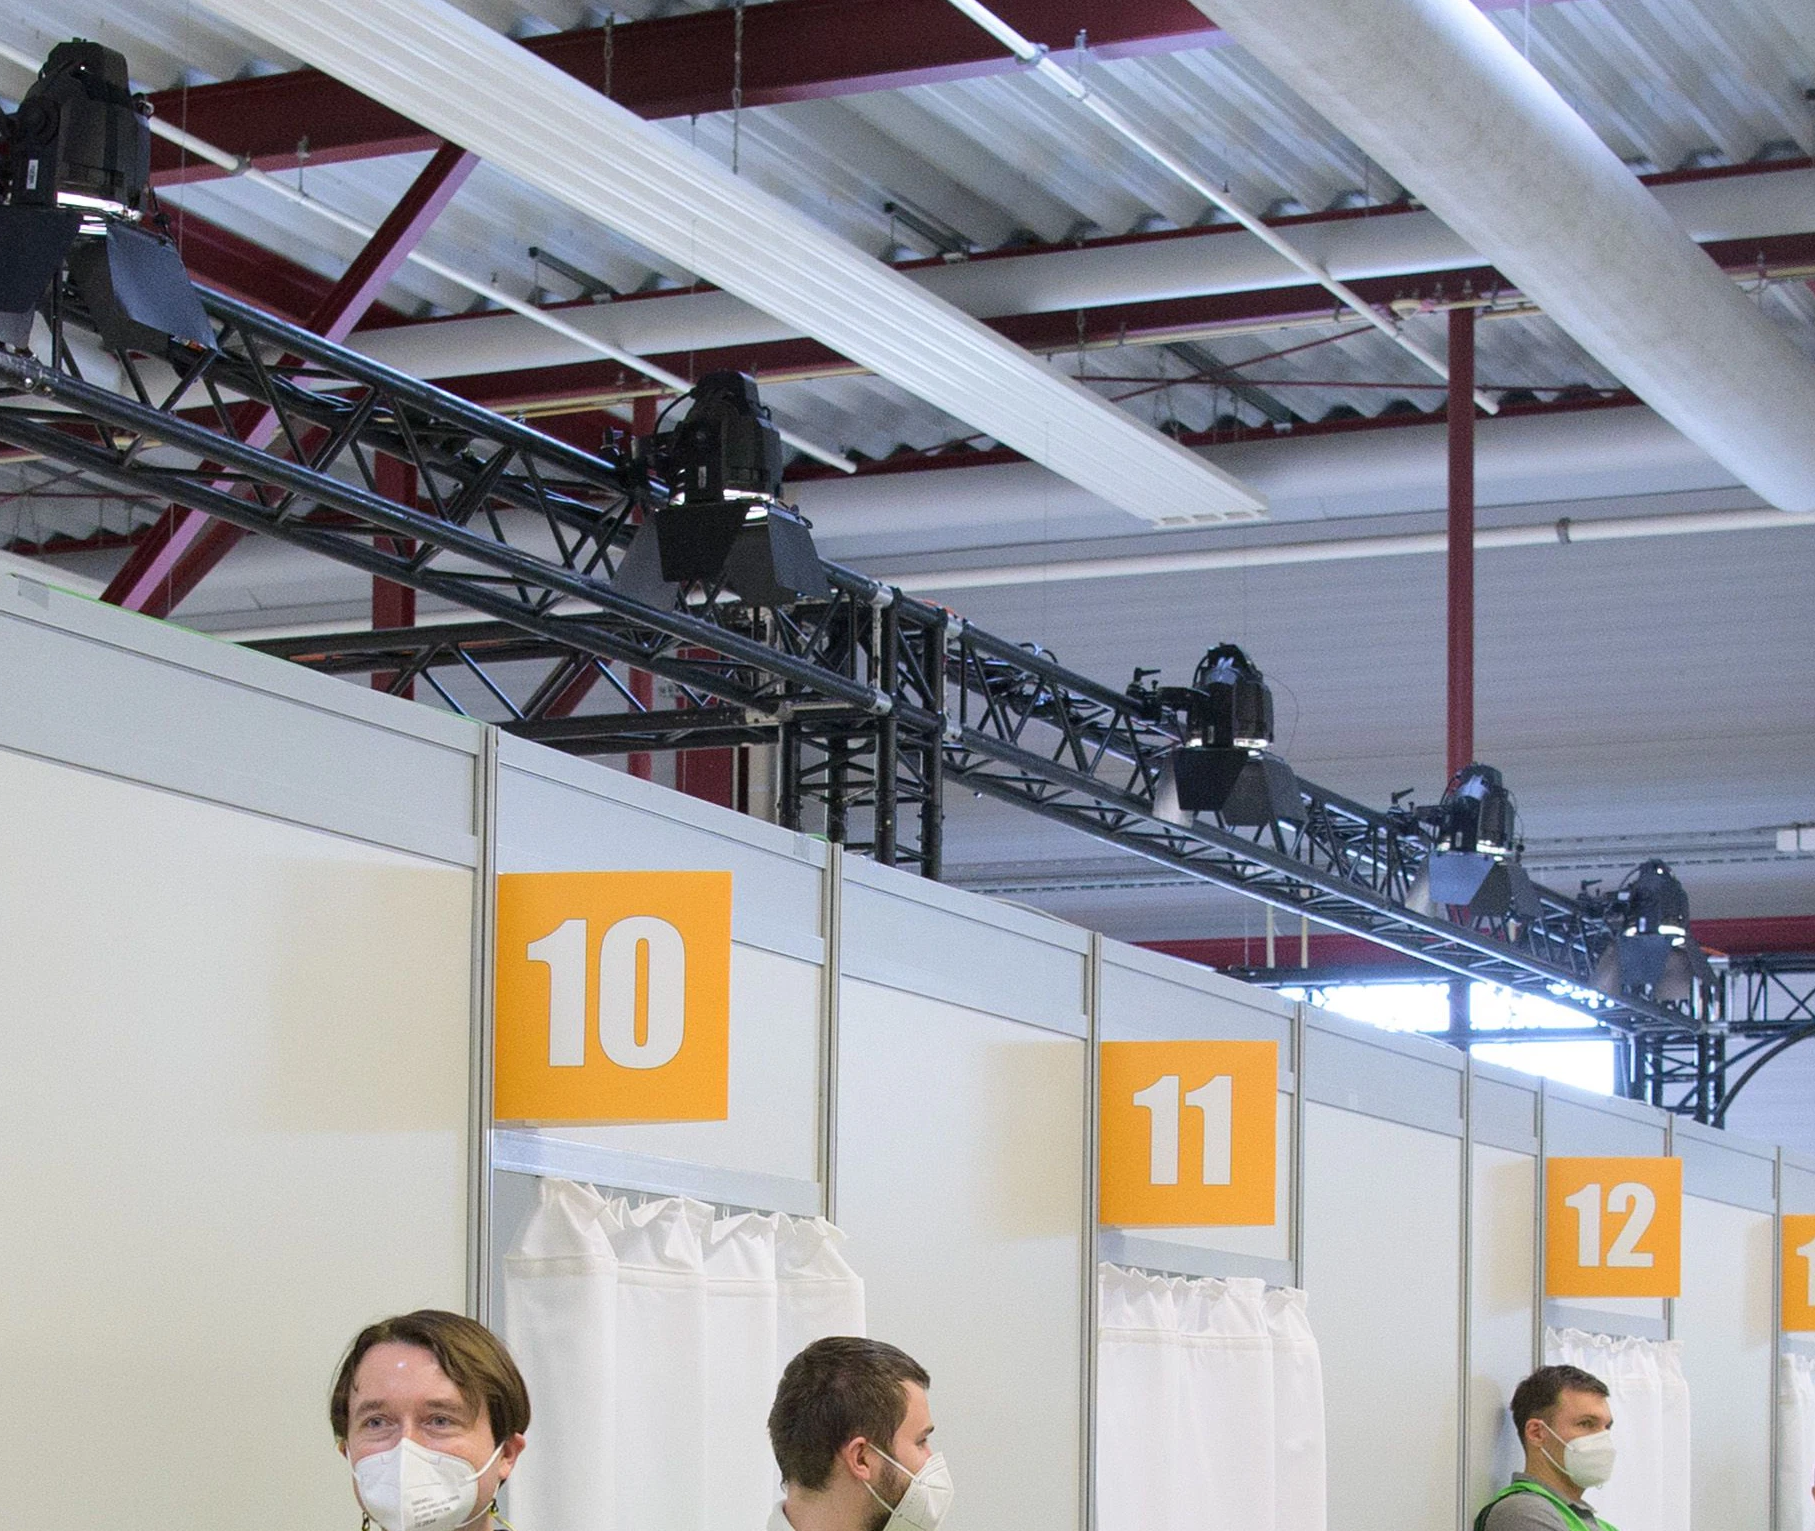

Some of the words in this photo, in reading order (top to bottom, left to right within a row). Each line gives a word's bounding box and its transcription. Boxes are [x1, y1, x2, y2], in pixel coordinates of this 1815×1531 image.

[526, 914, 686, 1070] 10
[1132, 1074, 1233, 1186] 11
[1564, 1180, 1657, 1268] 12
